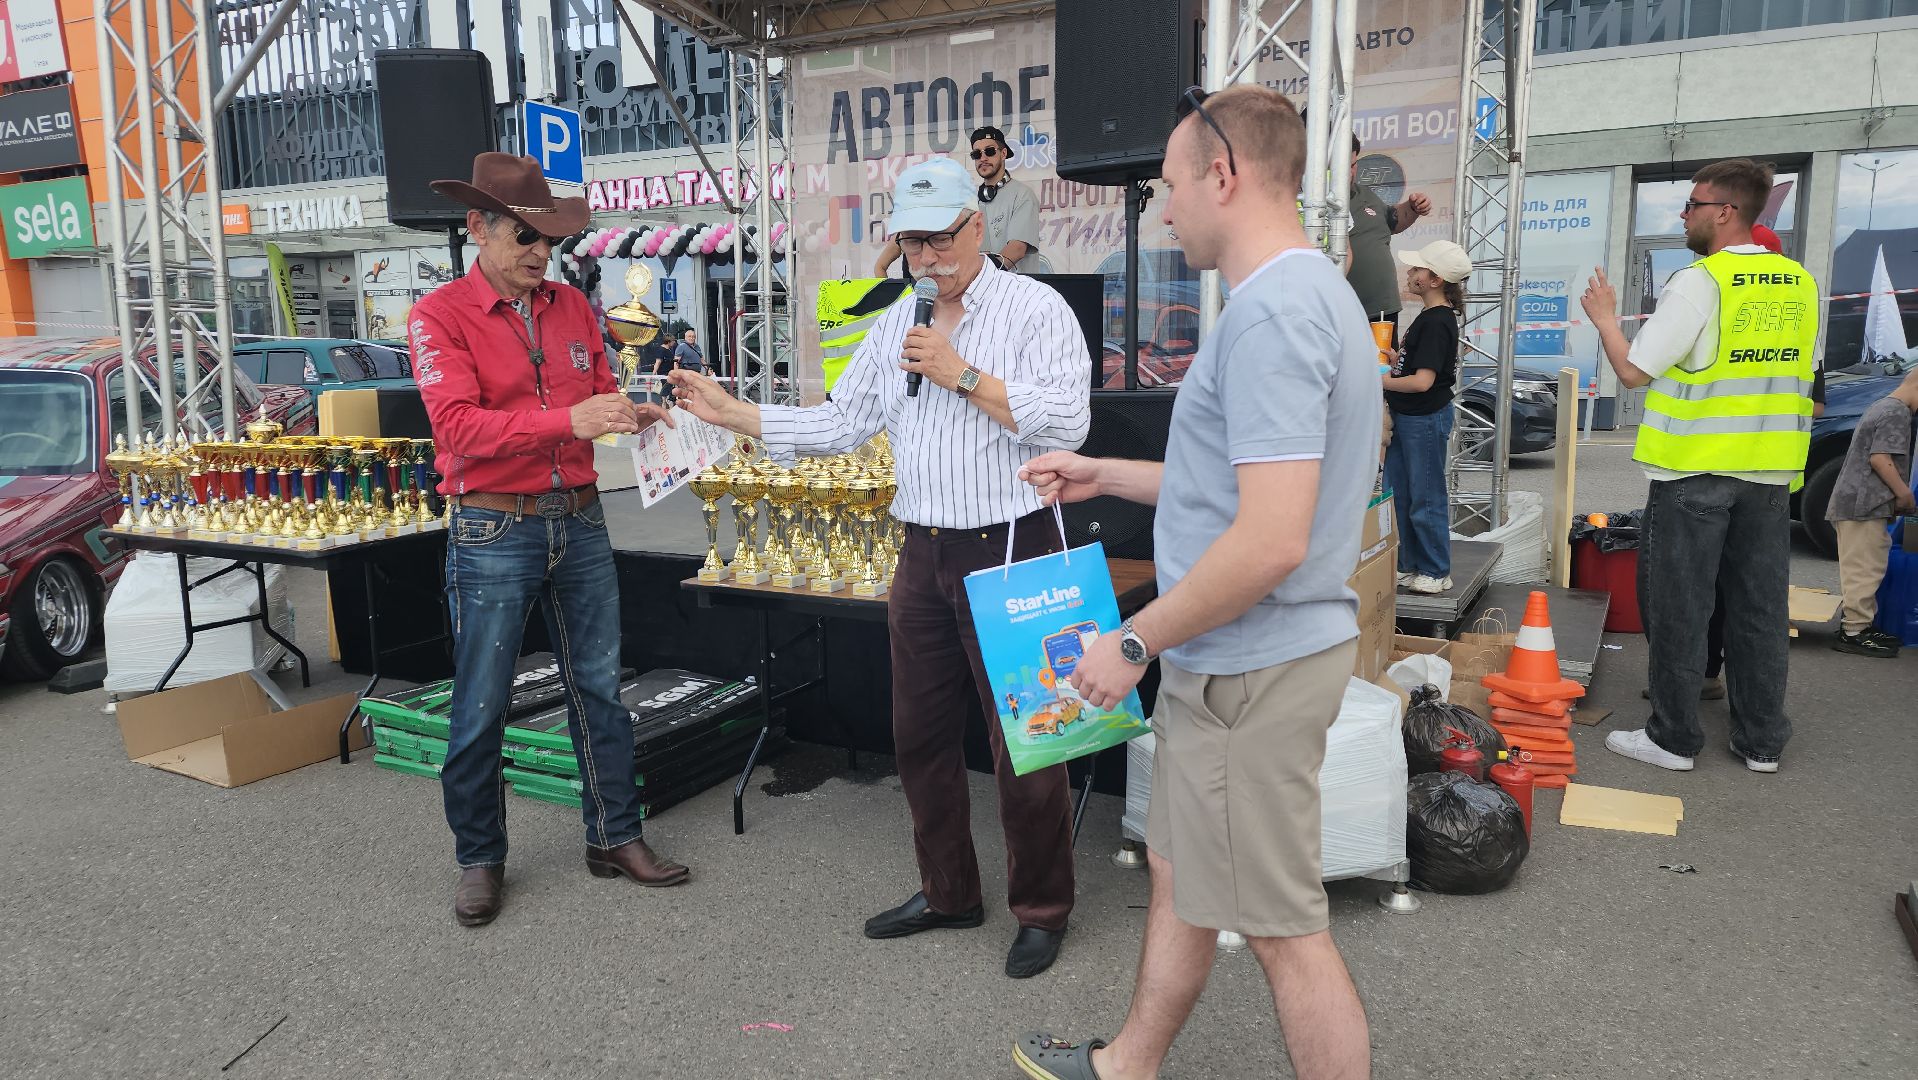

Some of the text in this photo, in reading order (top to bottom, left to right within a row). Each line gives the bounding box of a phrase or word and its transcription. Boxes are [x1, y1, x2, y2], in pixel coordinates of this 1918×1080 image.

[1259, 40, 1309, 63] РЕТР
[1257, 76, 1309, 96] НИЯ
[827, 63, 1050, 165] АВТОФЕ
[264, 125, 370, 165] АФИША
[540, 113, 571, 171] P
[1352, 114, 1399, 146] ДЛЯ
[588, 173, 673, 211] АНДА
[1553, 198, 1588, 213] для
[14, 192, 82, 244] sela
[262, 194, 365, 234] ТЕХНИКА
[1501, 216, 1592, 233] ильтров
[1732, 273, 1802, 287] STREET
[1520, 301, 1559, 313] СОЛЬ
[1005, 584, 1081, 615] StarLine
[638, 680, 710, 709] SGM
